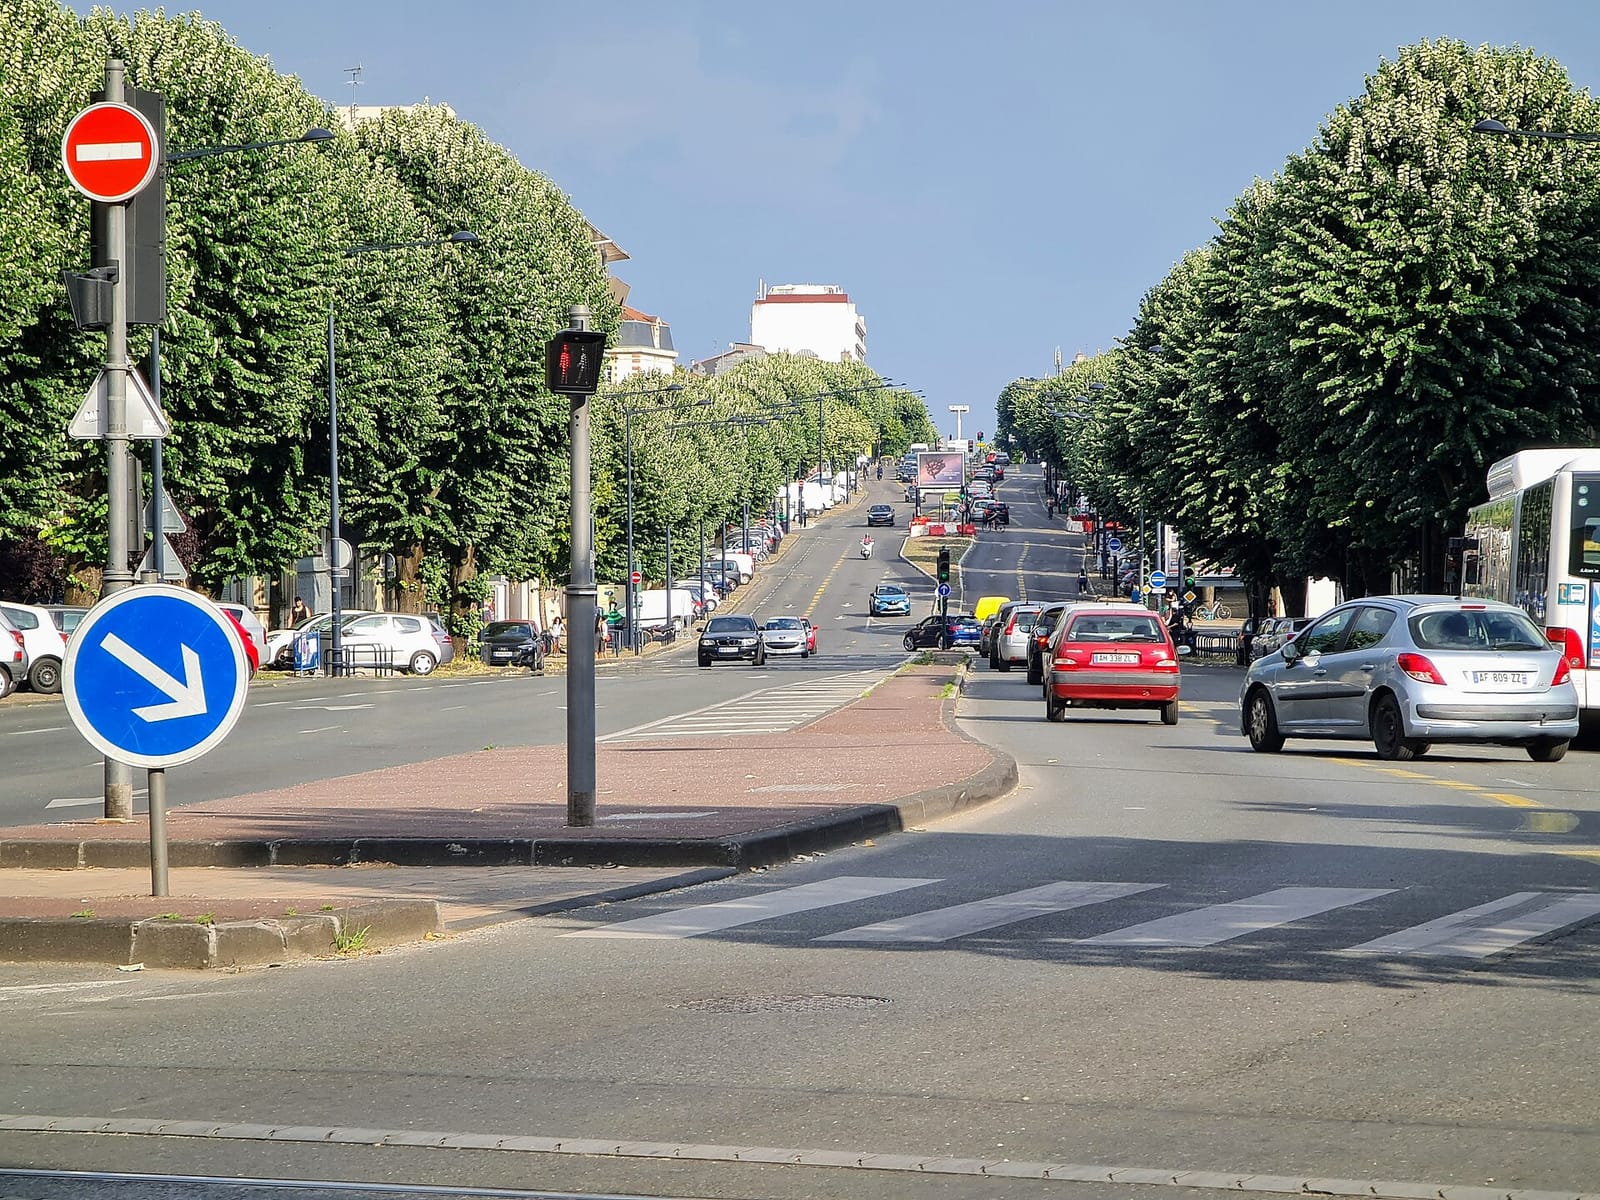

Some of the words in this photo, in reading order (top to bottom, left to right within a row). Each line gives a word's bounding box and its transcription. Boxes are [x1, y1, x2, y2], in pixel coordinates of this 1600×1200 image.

[1480, 673, 1488, 681] AF
[1493, 673, 1508, 682] 809
[1511, 673, 1521, 682] ZZ
